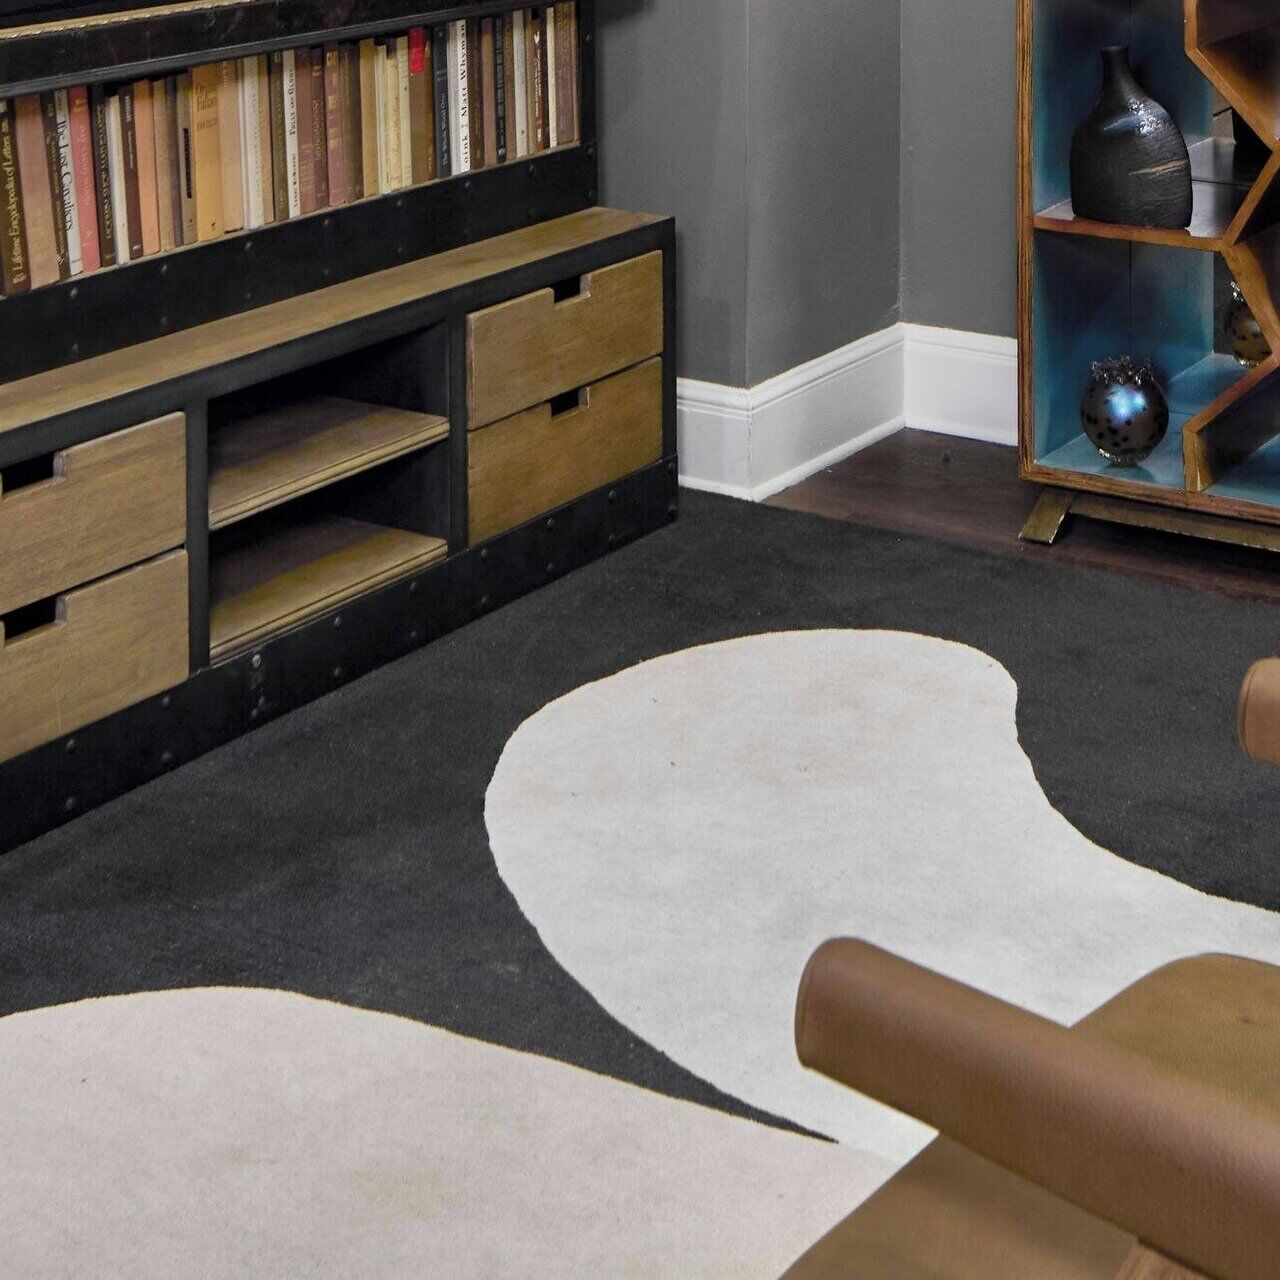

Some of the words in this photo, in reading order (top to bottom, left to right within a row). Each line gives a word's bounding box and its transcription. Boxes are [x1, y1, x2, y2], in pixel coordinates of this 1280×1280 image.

[460, 87, 468, 117] Matt
[57, 121, 66, 141] The
[1, 135, 12, 166] Letters
[59, 144, 69, 168] Last
[461, 135, 469, 164] oink
[62, 171, 75, 231] Cavaliers
[11, 236, 24, 271] Lifetime
